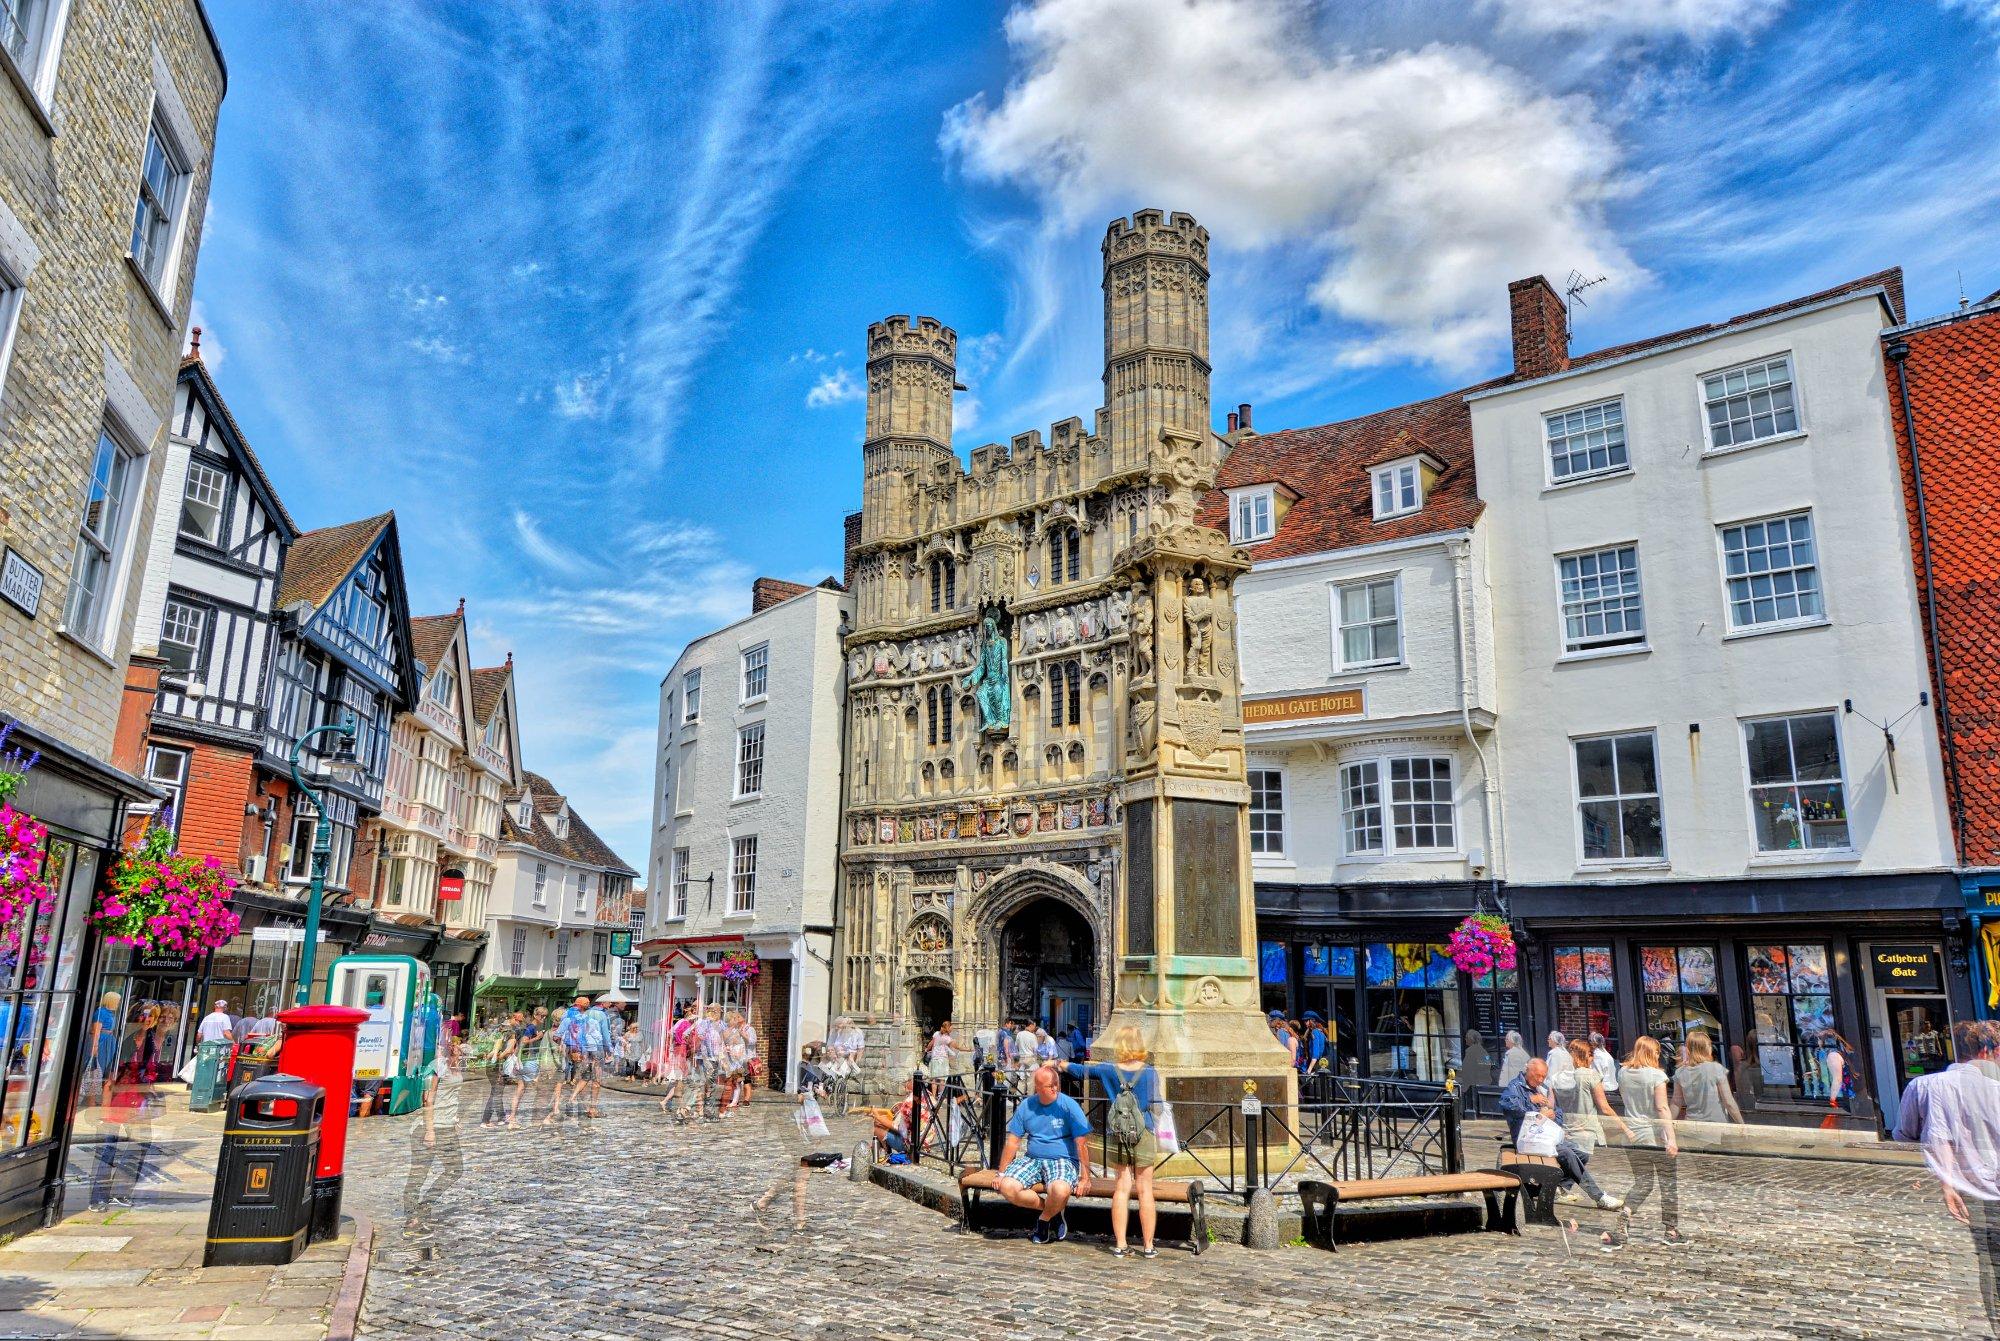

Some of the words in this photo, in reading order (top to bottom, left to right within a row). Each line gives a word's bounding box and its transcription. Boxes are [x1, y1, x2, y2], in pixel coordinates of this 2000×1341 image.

[9, 559, 39, 594] BUTTER
[3, 575, 37, 611] MARKET
[1289, 700, 1318, 714] GATE
[1320, 696, 1356, 711] HOTEL
[142, 947, 156, 957] Te
[141, 958, 185, 970] Canterbury
[1877, 953, 1928, 965] Cathedral
[1891, 967, 1918, 977] Gate
